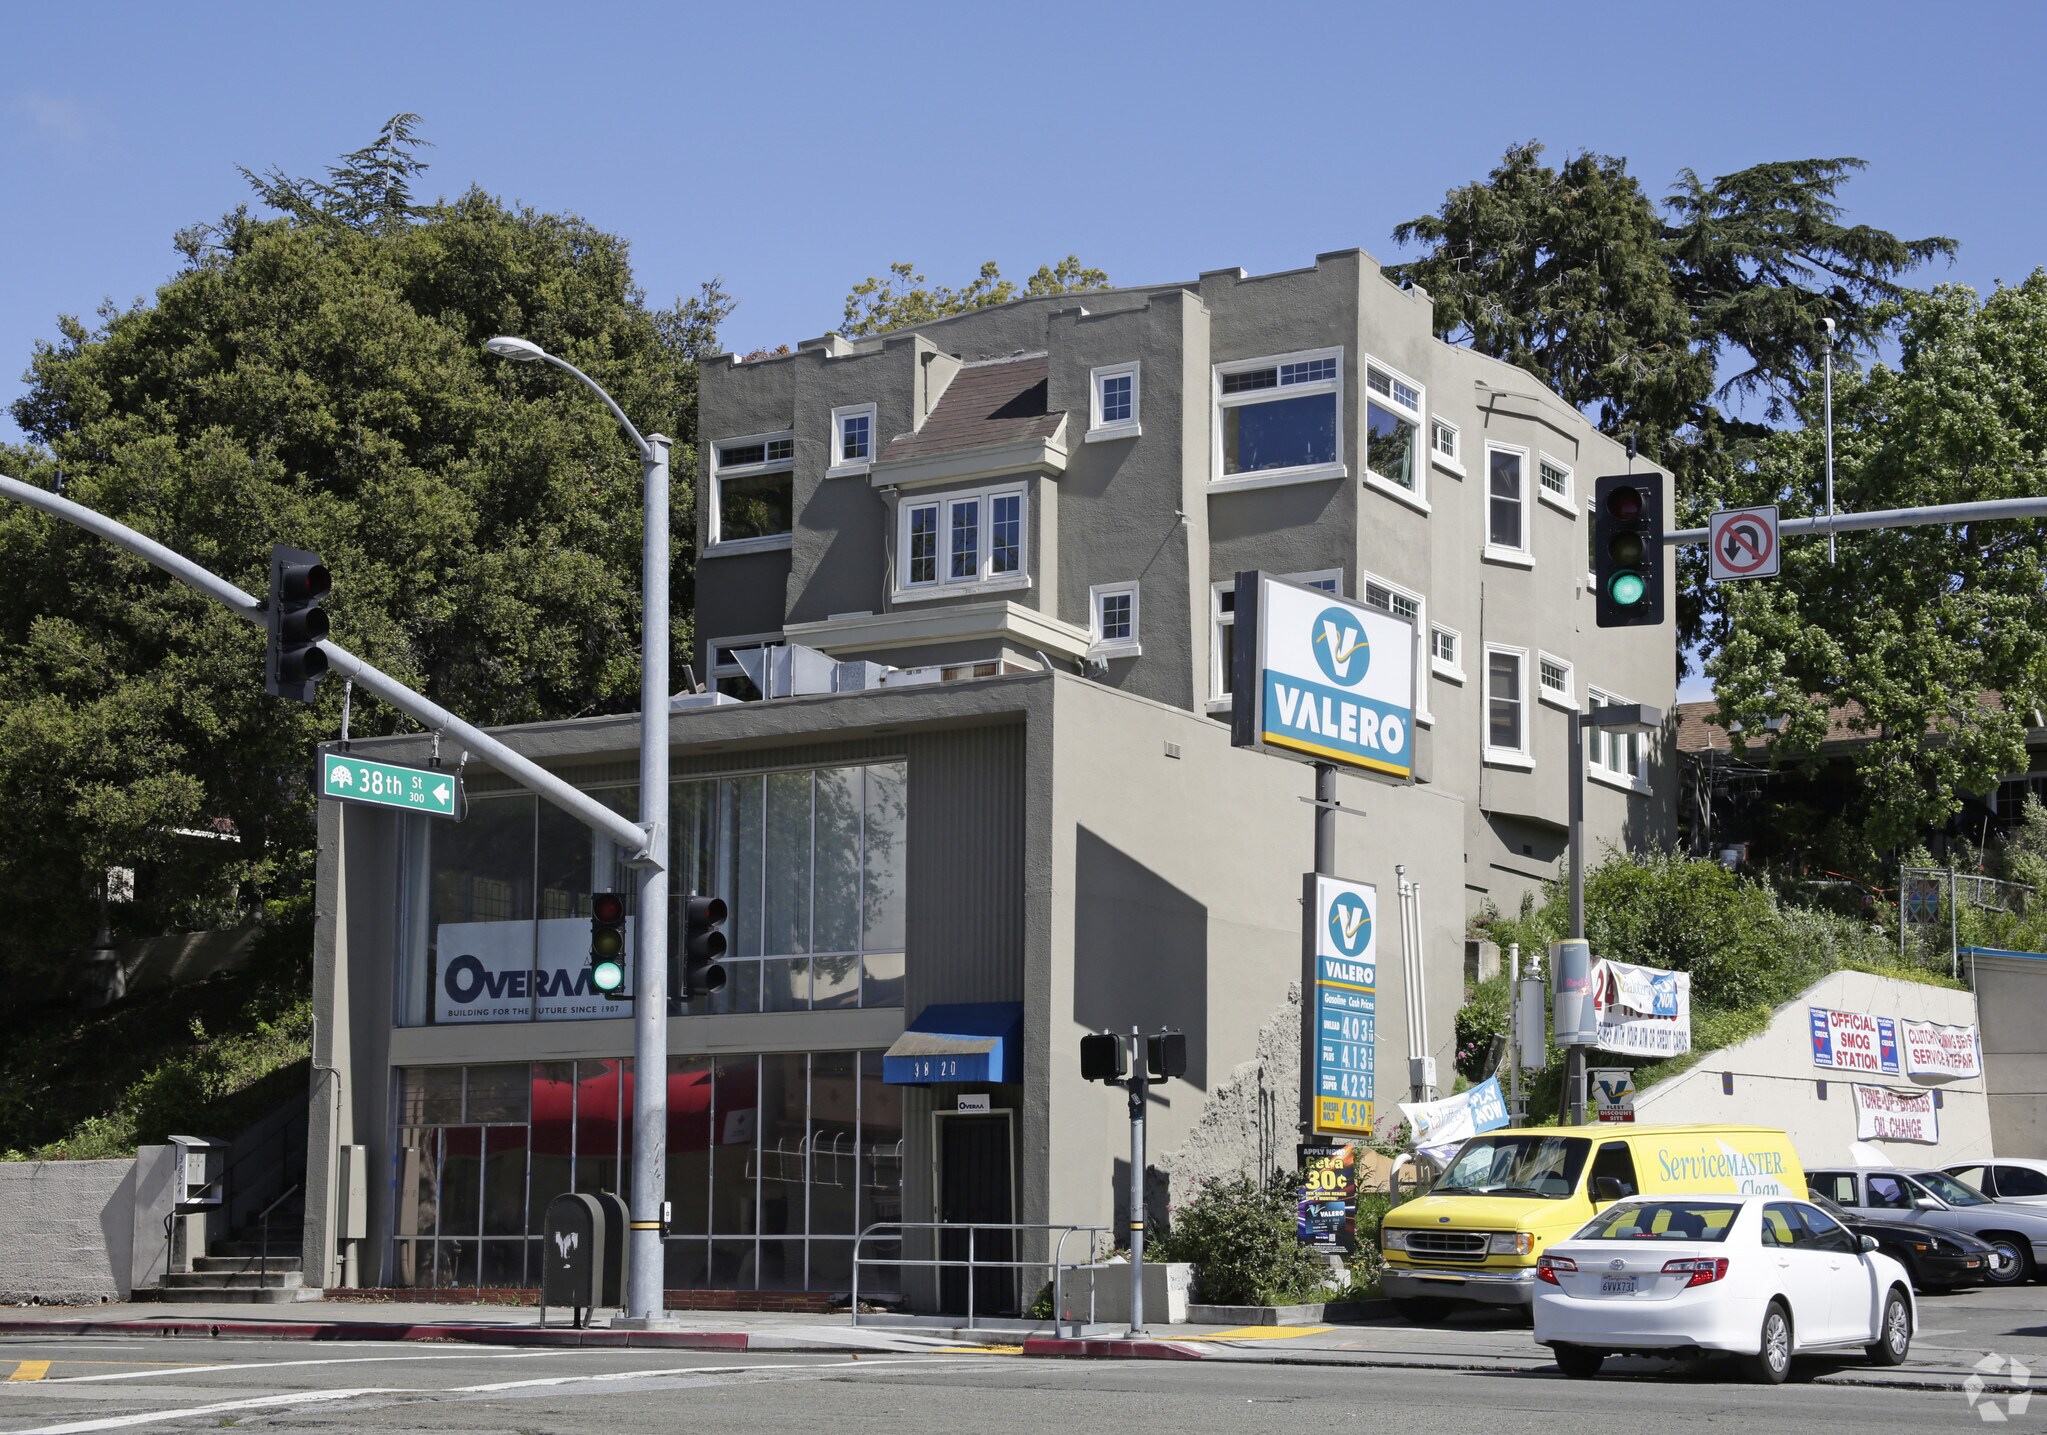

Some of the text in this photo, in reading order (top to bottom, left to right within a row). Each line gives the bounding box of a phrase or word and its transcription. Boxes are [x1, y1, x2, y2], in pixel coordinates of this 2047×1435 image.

[1274, 682, 1405, 755] VALERO
[359, 768, 422, 796] 38th St
[409, 791, 424, 803] 300
[1325, 960, 1374, 984] VALERO
[1324, 992, 1374, 1010] Gasoline Cash Prices
[448, 1008, 489, 1017] BUILDING
[511, 1007, 529, 1015] THE
[571, 1005, 597, 1014] SINCE
[601, 1005, 619, 1013] 1907
[1830, 1011, 1876, 1032] OFFICIAL
[1656, 1029, 1671, 1050] CREDIT
[1672, 1030, 1688, 1051] CARDS
[1840, 1031, 1871, 1050] SMOG
[1323, 1051, 1335, 1062] PLUS
[1836, 1049, 1878, 1070] STATION
[1322, 1080, 1338, 1091] SUPER
[1322, 1101, 1339, 1112] DIESEL
[1859, 1087, 1894, 1112] TUNE-UP
[1475, 1100, 1503, 1125] NOW
[1874, 1115, 1922, 1139] OIL CHANGE
[1303, 1148, 1325, 1156] APPLY
[1334, 1158, 1344, 1169] a
[1658, 1147, 1784, 1182] ServiceMASTER
[1305, 1170, 1347, 1190] 30¢
[1320, 1210, 1345, 1218] VALERO
[1602, 1281, 1635, 1292] 6VVX731
